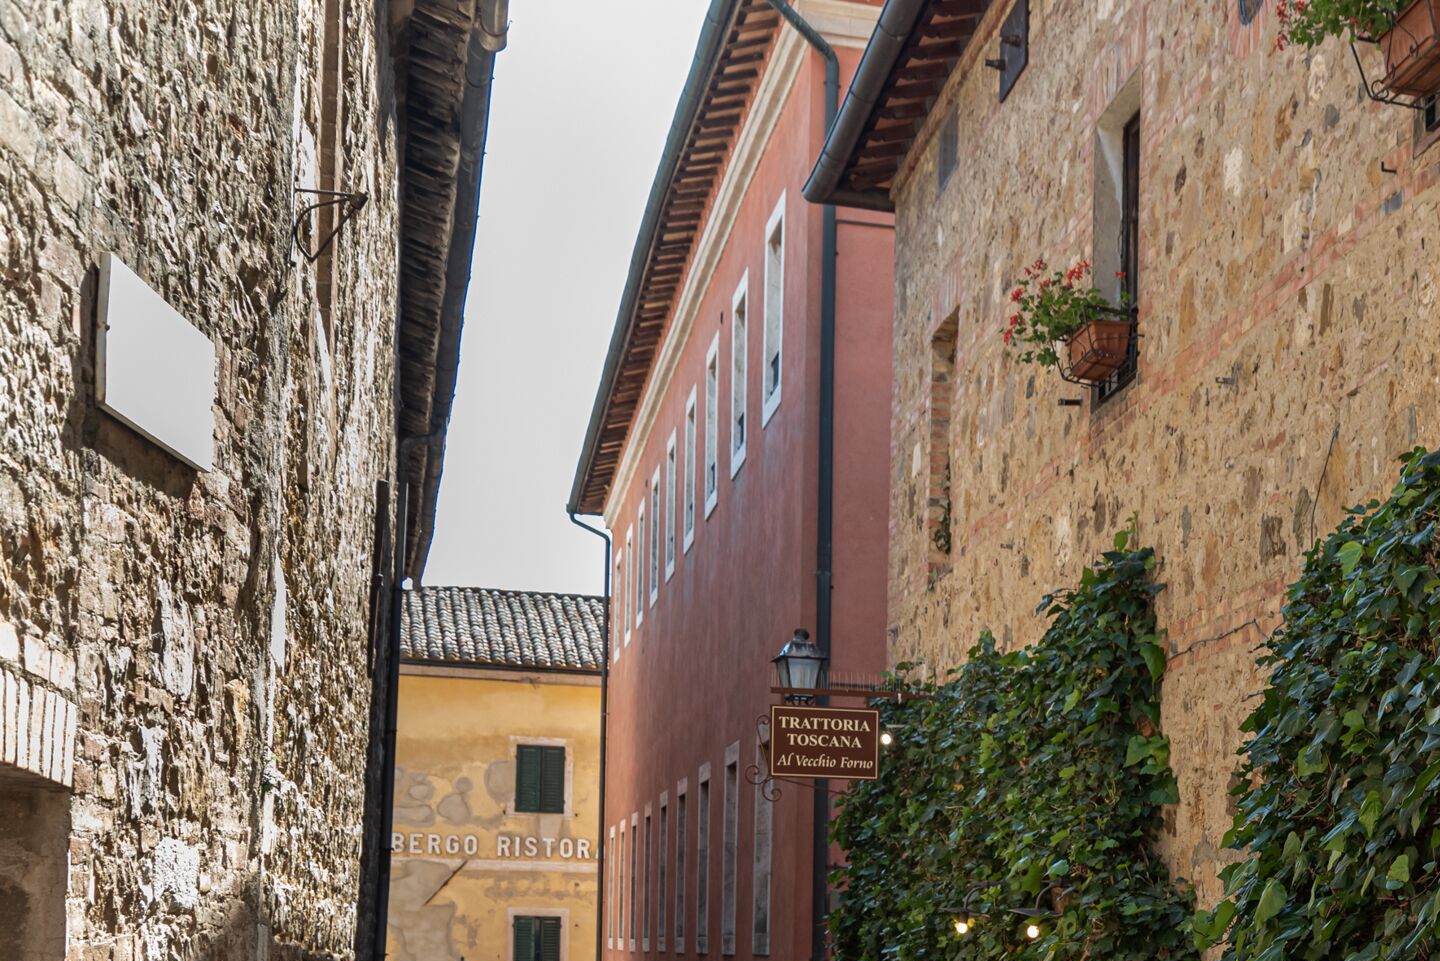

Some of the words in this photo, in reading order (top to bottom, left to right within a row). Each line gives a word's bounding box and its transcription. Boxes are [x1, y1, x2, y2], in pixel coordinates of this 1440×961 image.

[778, 716, 871, 732] TRATTORIA
[787, 733, 862, 749] TOSCANA
[777, 752, 794, 766] Al
[796, 753, 837, 768] Vecchio
[840, 757, 873, 769] Forno
[391, 832, 478, 855] BERGO
[497, 835, 598, 859] RISTOR
